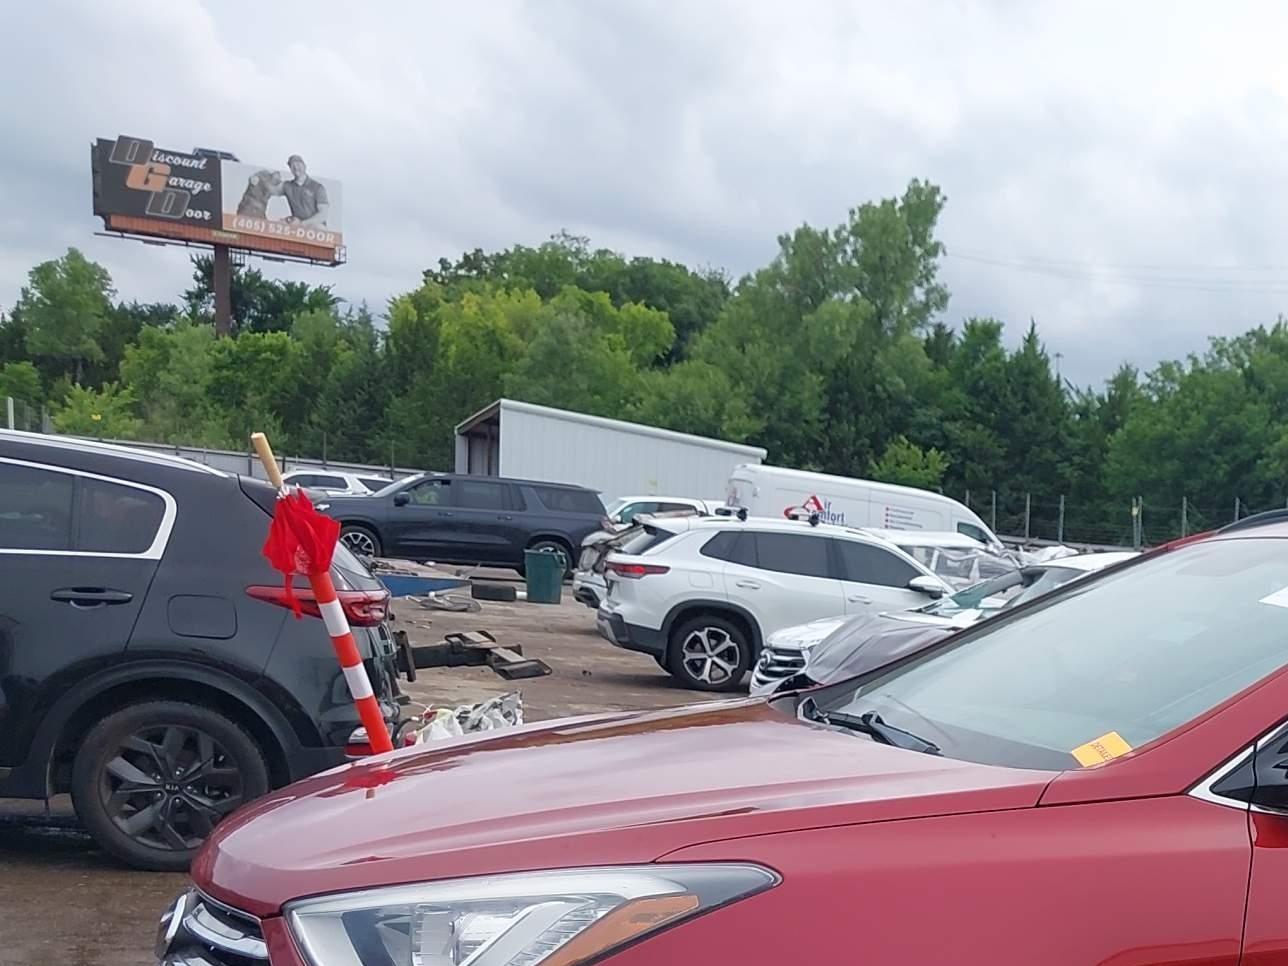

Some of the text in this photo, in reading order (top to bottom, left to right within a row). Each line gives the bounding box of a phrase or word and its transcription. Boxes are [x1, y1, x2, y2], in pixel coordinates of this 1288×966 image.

[109, 135, 208, 169] Discount
[126, 162, 212, 195] Garage
[145, 187, 212, 221] Door
